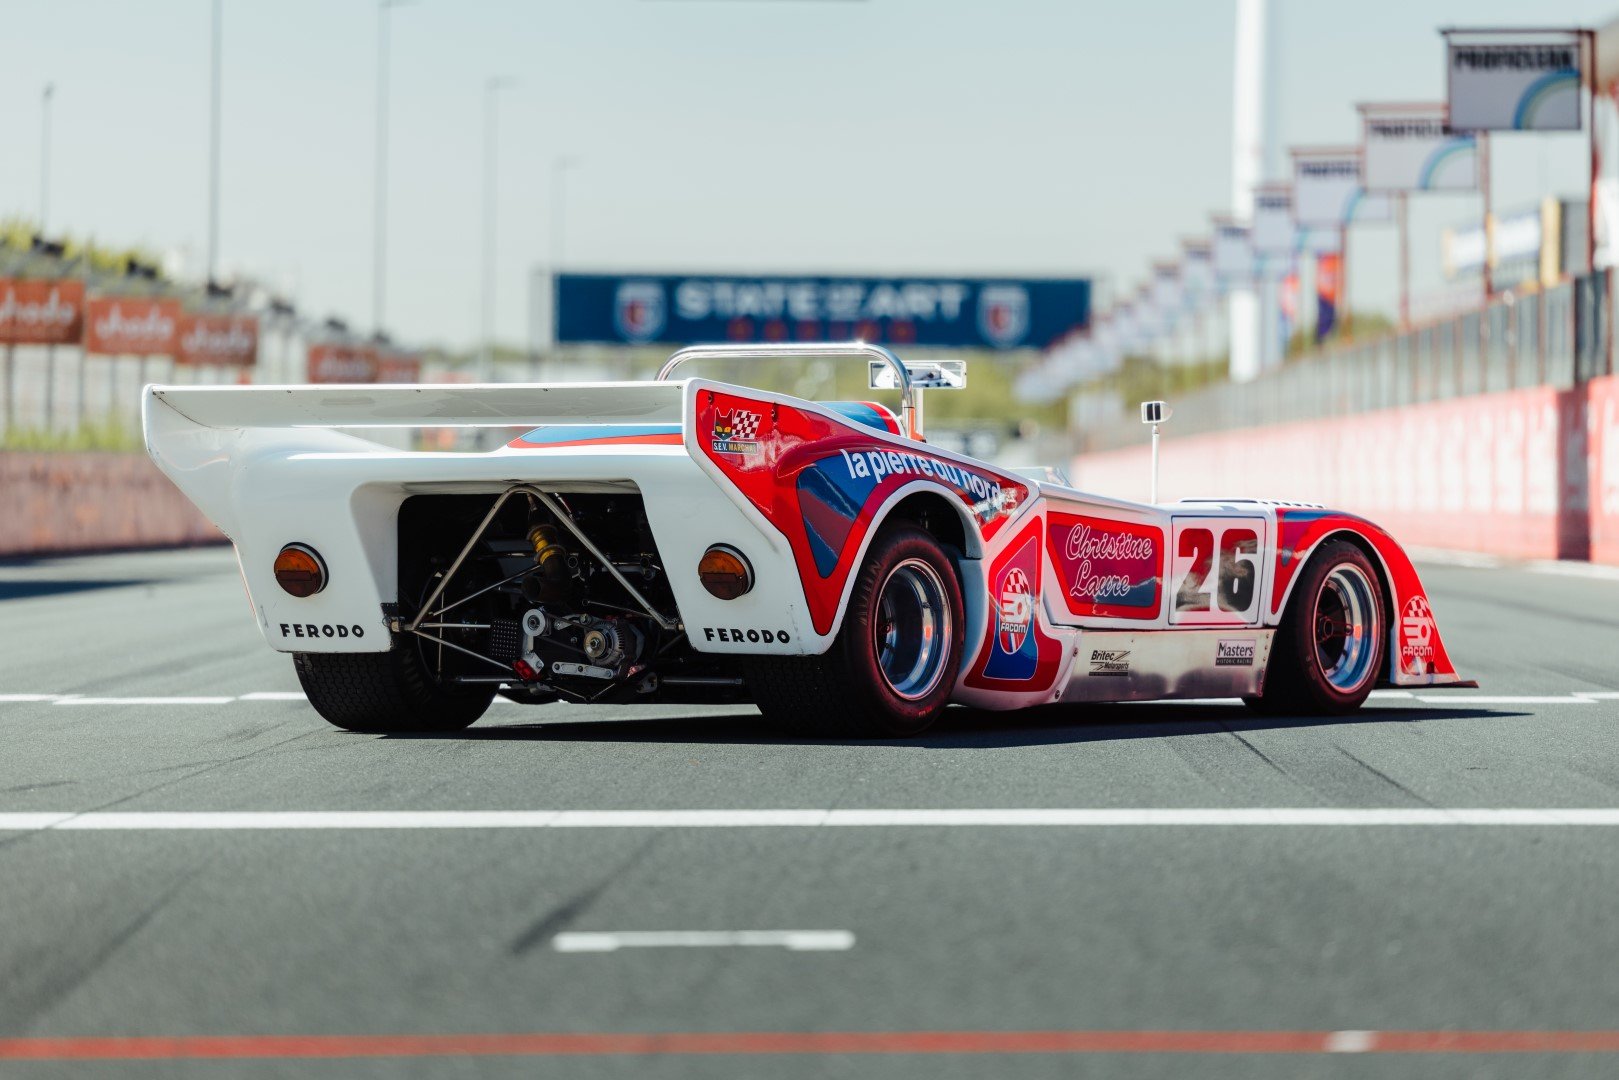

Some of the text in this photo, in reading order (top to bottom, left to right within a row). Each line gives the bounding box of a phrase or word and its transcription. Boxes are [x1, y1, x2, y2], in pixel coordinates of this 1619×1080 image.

[676, 280, 817, 319] STATE
[865, 282, 967, 321] ART
[713, 442, 728, 451] S.E.V.
[840, 448, 870, 480] la
[867, 447, 935, 483] pierre
[1066, 523, 1152, 561] Christine
[1070, 559, 1131, 597] Laure
[1175, 528, 1258, 612] 26
[280, 623, 365, 638] FERODO
[703, 628, 790, 644] FERODO
[1000, 622, 1026, 634] FACOM
[1091, 650, 1114, 660] Britec
[1217, 641, 1254, 657] Masters
[1402, 646, 1433, 657] FACOM
